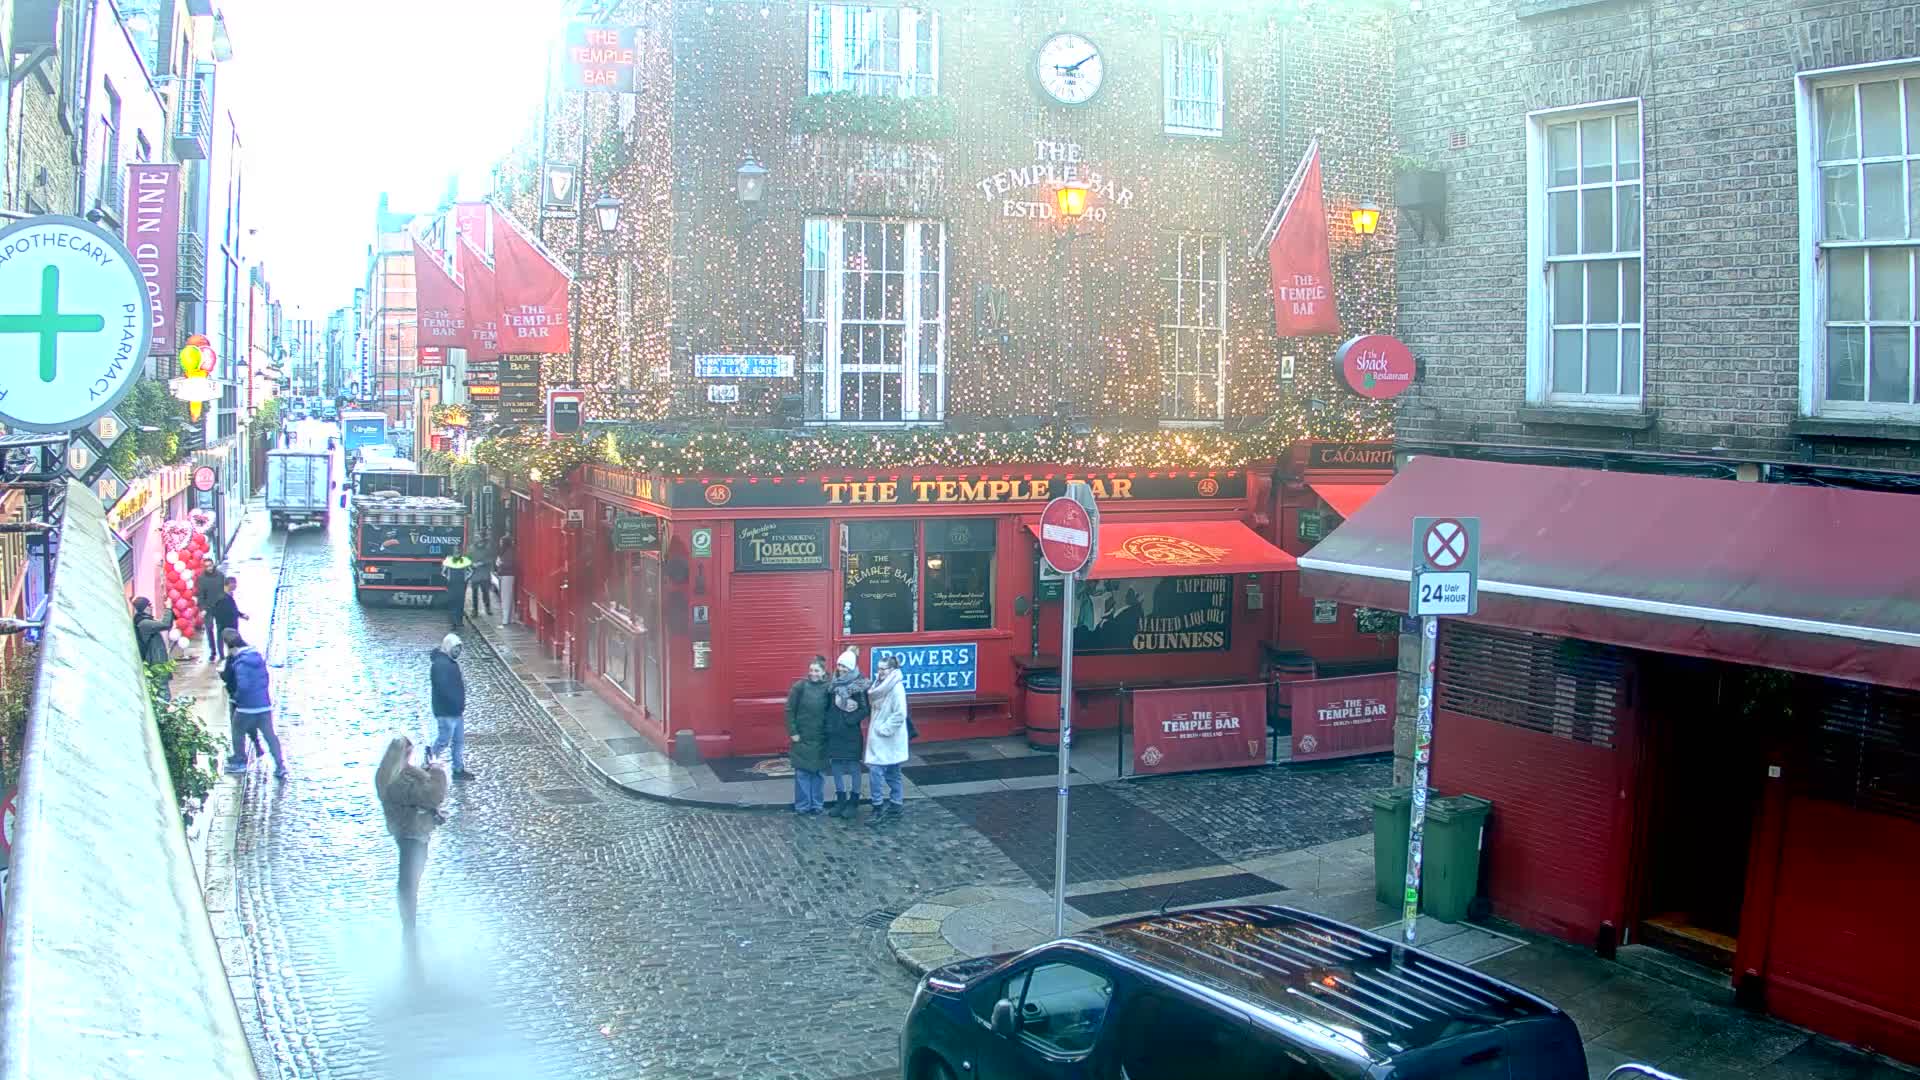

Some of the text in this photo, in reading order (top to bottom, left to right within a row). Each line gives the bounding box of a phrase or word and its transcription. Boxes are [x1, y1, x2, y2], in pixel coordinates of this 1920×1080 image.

[1033, 138, 1082, 162] THE
[976, 162, 1134, 209] TEMPLE BAR
[137, 171, 169, 233] NINE
[1294, 275, 1313, 286] THE
[1279, 286, 1326, 300] TEMPLE
[520, 305, 545, 314] THE
[1293, 303, 1314, 315] BAR
[422, 319, 465, 329] TEMPLE
[503, 313, 564, 327] TEMPLE
[432, 328, 456, 336] BAR
[472, 330, 497, 340] TEM
[517, 327, 550, 338] BAR
[88, 303, 137, 401] PHARMACY
[1356, 350, 1388, 373] Shack
[636, 478, 652, 499] BAR
[823, 481, 899, 503] THE
[912, 479, 1050, 502] TEMPLE
[419, 535, 462, 545] GUINNESS
[750, 539, 816, 561] TOBACCO
[1176, 578, 1226, 593] EMPEROR
[1212, 594, 1224, 606] OF
[1421, 584, 1443, 603] 24
[1444, 594, 1466, 602] HOUR
[1138, 617, 1182, 632] MALTED
[1132, 631, 1224, 650] GUINNESS
[874, 670, 974, 689] HISKEY
[1344, 699, 1362, 708] THE
[1191, 711, 1213, 720] THE
[1317, 704, 1387, 720] TEMPLE BAR
[1162, 717, 1241, 732] TEMPLE BAR
